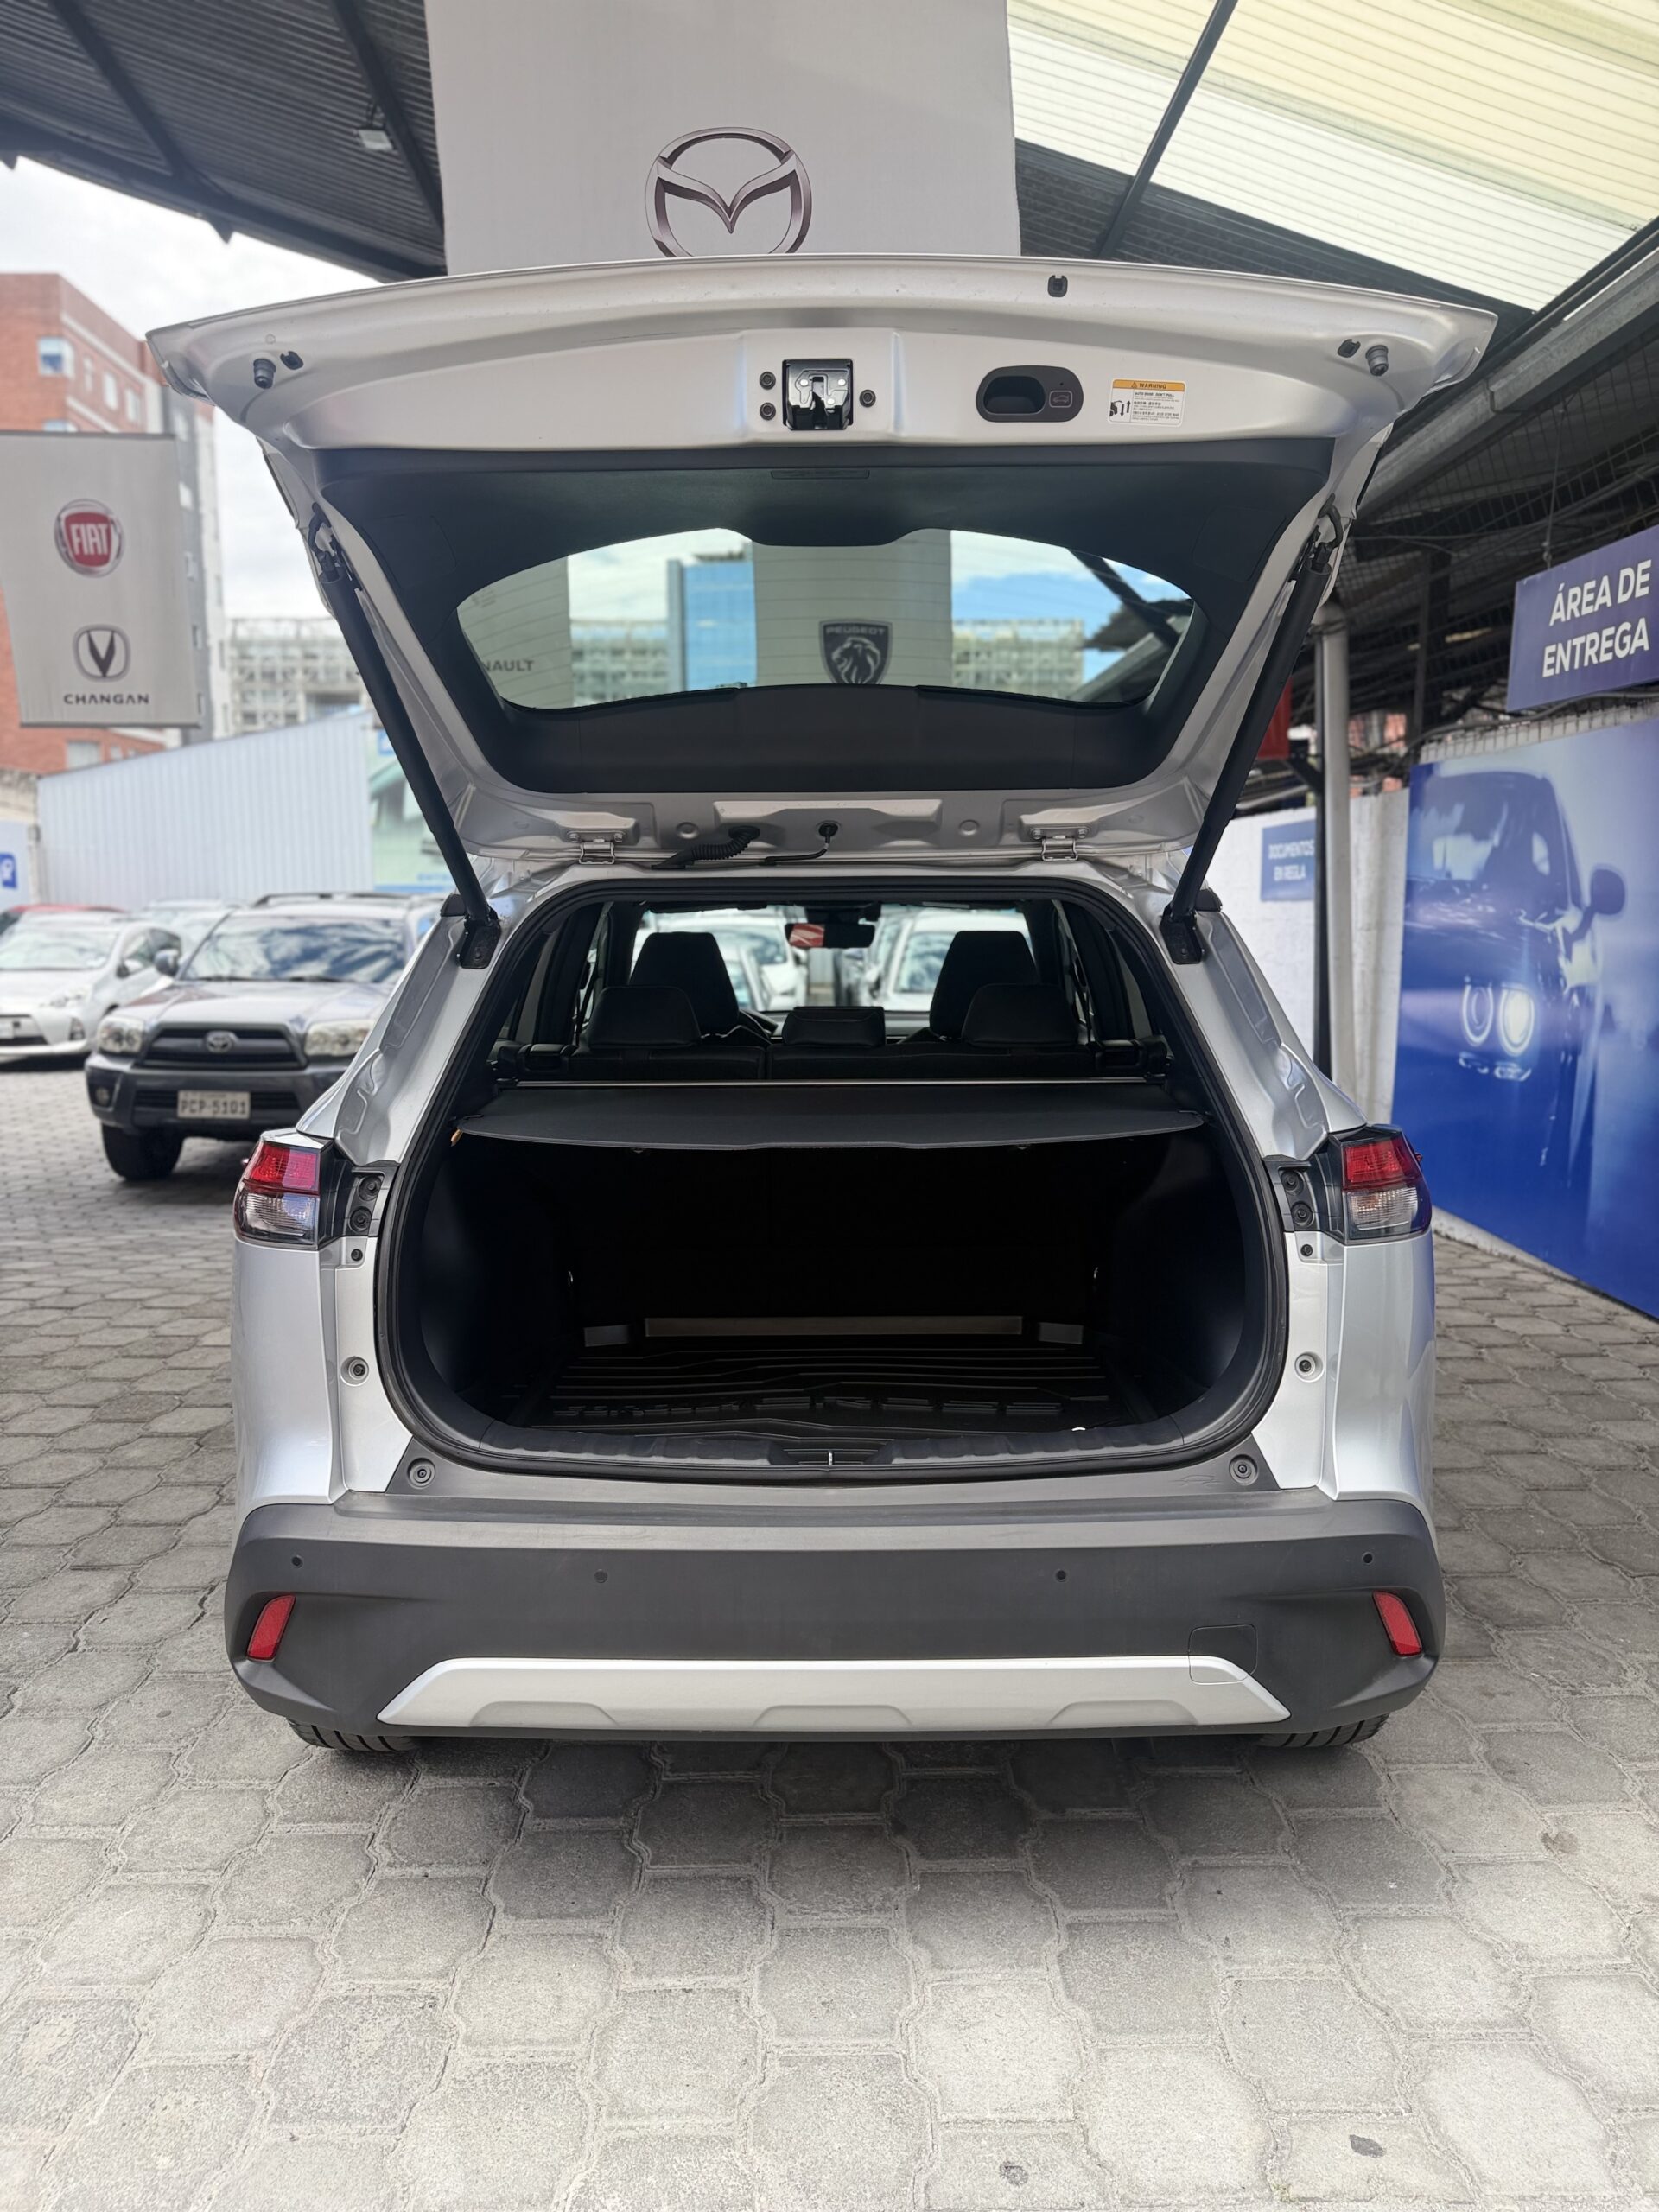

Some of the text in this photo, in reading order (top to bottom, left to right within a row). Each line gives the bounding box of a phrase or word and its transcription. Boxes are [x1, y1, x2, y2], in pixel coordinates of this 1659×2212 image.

[70, 524, 109, 556] FIAT
[1549, 559, 1652, 626] ÁREA DE
[826, 626, 885, 635] PEUGEOT
[1542, 617, 1649, 678] ENTREGA
[485, 658, 535, 672] NAULT
[63, 693, 149, 705] CHANGAN
